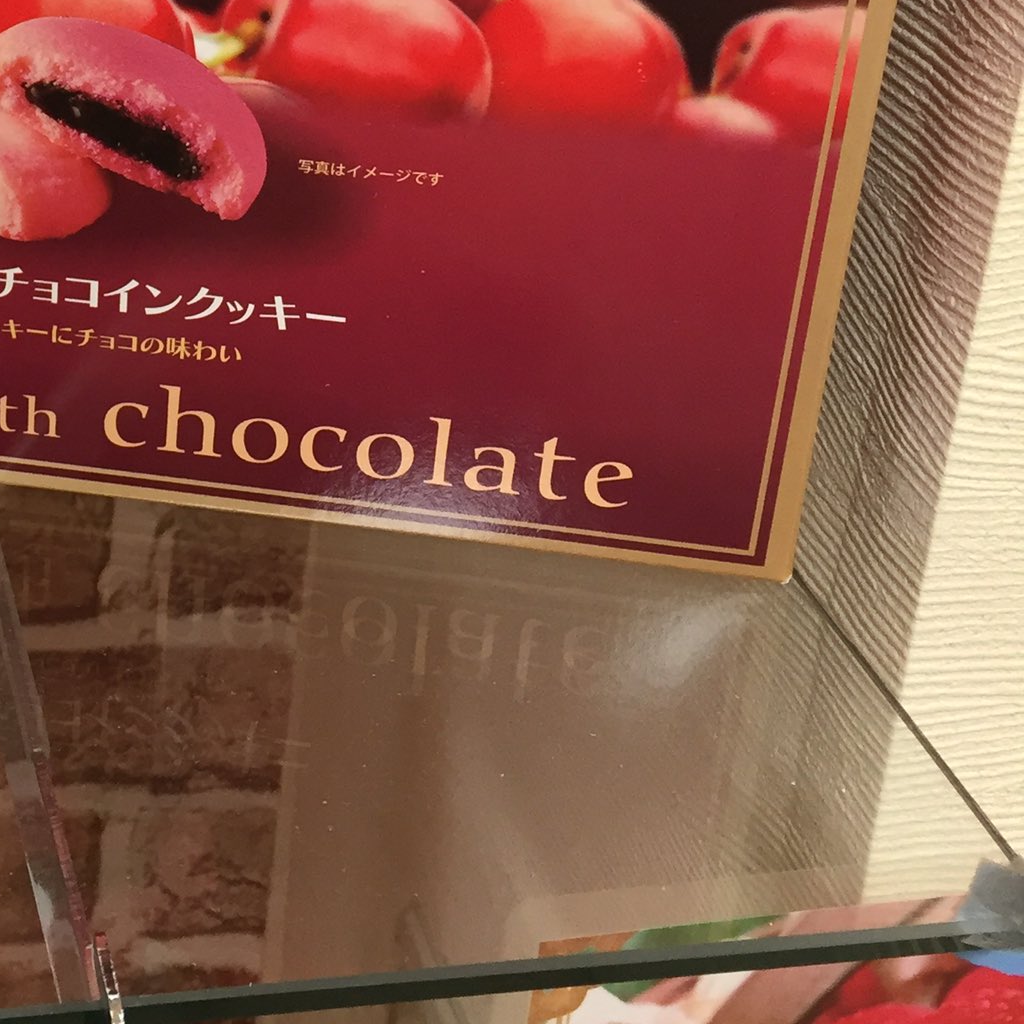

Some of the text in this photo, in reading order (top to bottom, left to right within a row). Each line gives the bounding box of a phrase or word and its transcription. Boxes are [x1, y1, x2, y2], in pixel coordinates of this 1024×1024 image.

[297, 158, 444, 187] 写真はイメージです
[103, 384, 634, 509] chocolate
